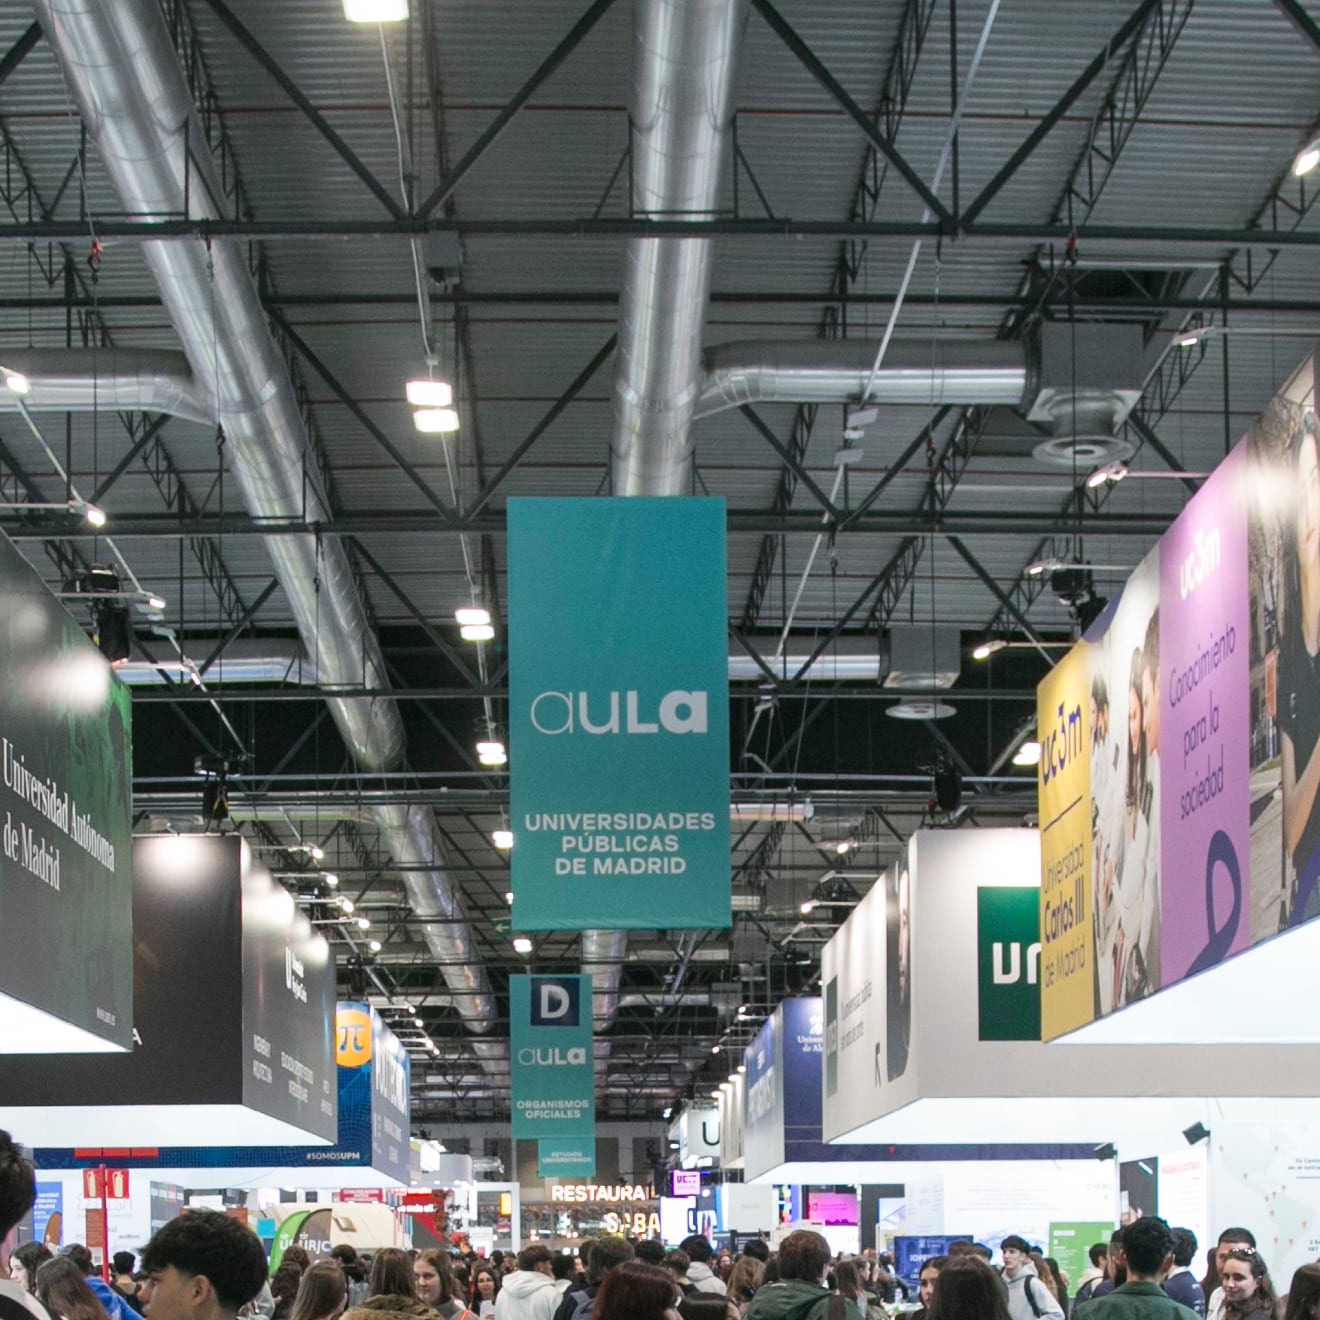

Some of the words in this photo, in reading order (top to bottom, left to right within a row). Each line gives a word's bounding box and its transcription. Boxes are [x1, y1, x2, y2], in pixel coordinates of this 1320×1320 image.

[1179, 524, 1221, 601] uc3m
[1169, 621, 1236, 709] Conocimiento
[1040, 700, 1083, 787] uc3m
[1183, 708, 1208, 772] para
[1209, 702, 1221, 736] la
[2, 737, 69, 835] Universidad
[70, 800, 115, 873] Autónoma
[1180, 761, 1225, 821] sociedad
[524, 812, 716, 832] UNIVERSIDADES
[562, 831, 679, 854] PÚBLICAS
[3, 811, 19, 862] de
[20, 822, 60, 891] Madrid
[555, 857, 587, 876] DE
[593, 856, 686, 876] MADRID
[1043, 832, 1085, 896] Universidad
[1043, 894, 1073, 944] Carlos
[1073, 890, 1085, 928] III
[1044, 958, 1055, 989] de
[1056, 943, 1086, 981] Madrid
[540, 984, 570, 1020] D
[516, 1099, 589, 1109] ORGANISMOS
[525, 1109, 582, 1119] OFICIALES
[306, 1151, 361, 1161] #SOMOSUPM
[298, 1239, 331, 1255] URJC
